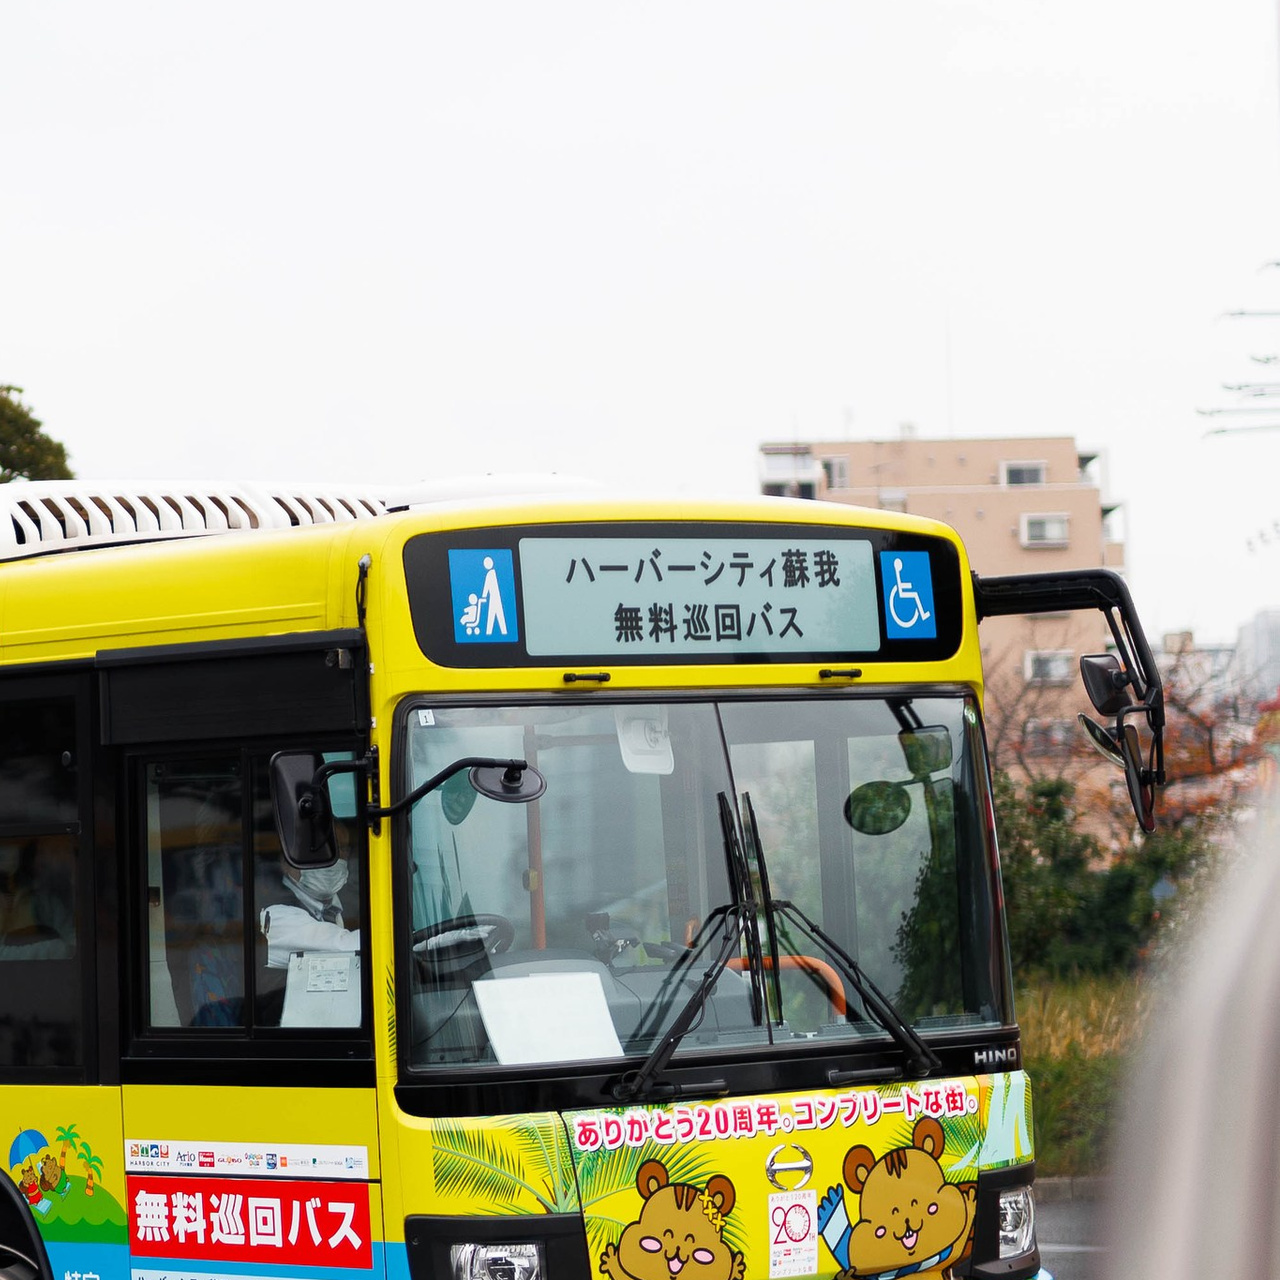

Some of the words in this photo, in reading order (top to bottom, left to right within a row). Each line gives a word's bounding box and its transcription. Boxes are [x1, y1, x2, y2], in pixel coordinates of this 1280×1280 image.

[565, 549, 841, 589] ハーバーシティ蘇我
[613, 603, 805, 644] 無料巡回バス
[974, 1047, 1017, 1064] HINO
[176, 1151, 196, 1162] Ario
[135, 1189, 363, 1251] 無料巡回バス
